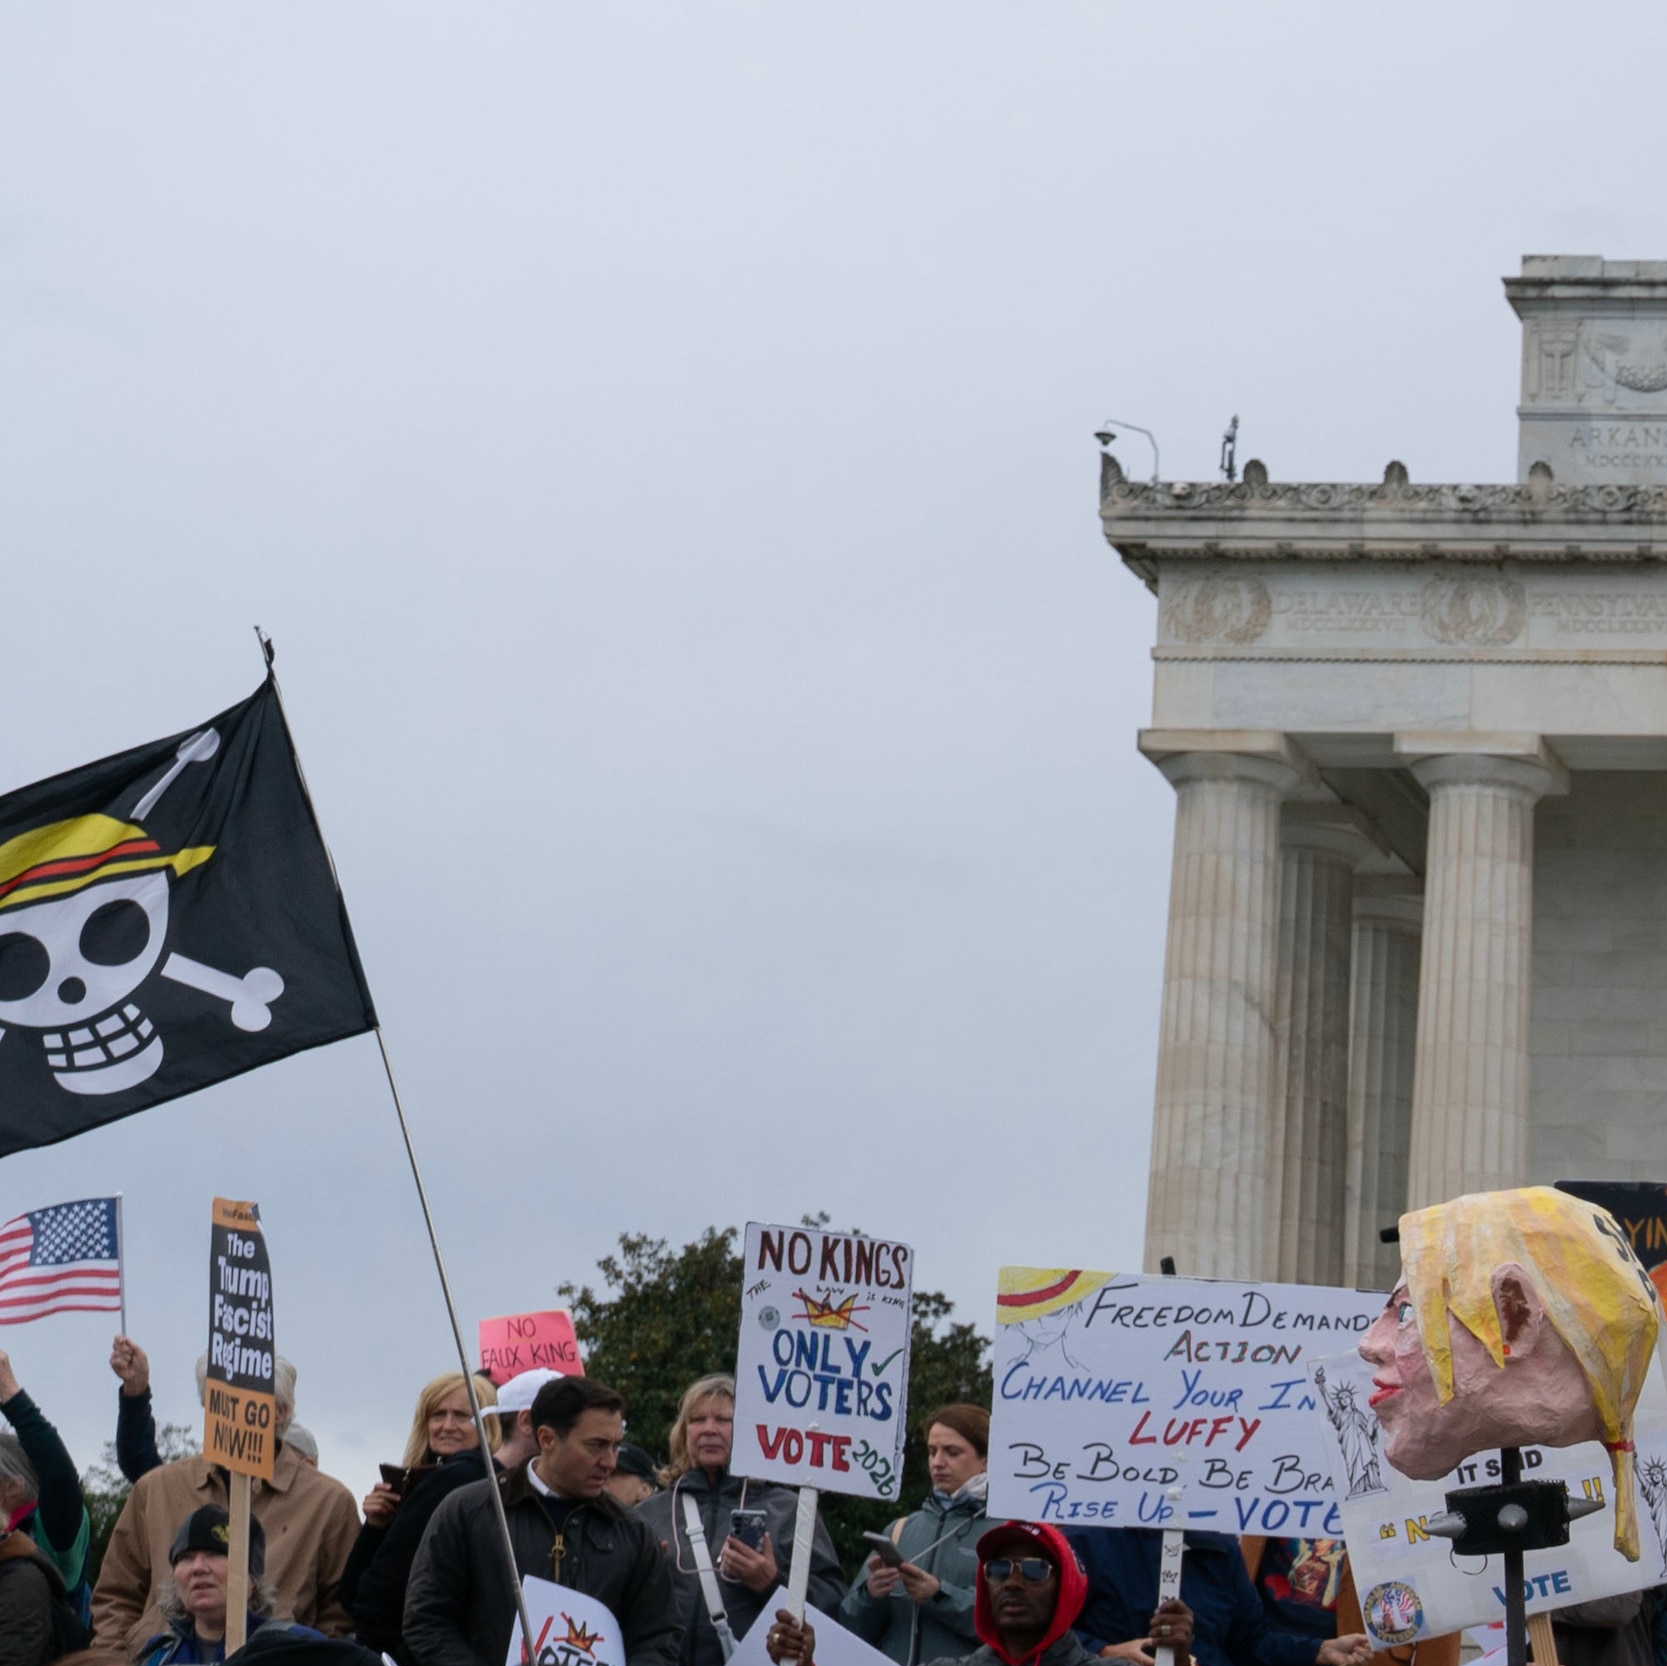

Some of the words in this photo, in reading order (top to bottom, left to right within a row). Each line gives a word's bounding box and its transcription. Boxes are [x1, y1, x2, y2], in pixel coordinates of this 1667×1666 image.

[226, 1231, 256, 1260] The
[756, 1229, 813, 1276] NO
[818, 1234, 908, 1291] KINGS
[217, 1255, 271, 1308] Trump
[213, 1293, 273, 1342] Fascist
[507, 1317, 537, 1340] NO
[1085, 1283, 1235, 1329] FREEDOM
[481, 1345, 526, 1370] FAUX
[529, 1340, 577, 1365] KING
[772, 1327, 872, 1381] ONLY
[1163, 1329, 1303, 1365] ACTION
[208, 1387, 240, 1423] MUST
[243, 1399, 271, 1430] GO
[757, 1364, 893, 1422] VOTERS
[1000, 1361, 1151, 1404] CHANNEL
[1172, 1369, 1244, 1412] YOUR
[212, 1419, 264, 1465] NOW!!!
[1128, 1409, 1262, 1453] LUFFY
[755, 1423, 853, 1473] VOTE
[851, 1438, 897, 1498] 2026
[1456, 1463, 1479, 1485] IT
[1029, 1481, 1119, 1520] RISE
[1234, 1496, 1344, 1536] VOTE
